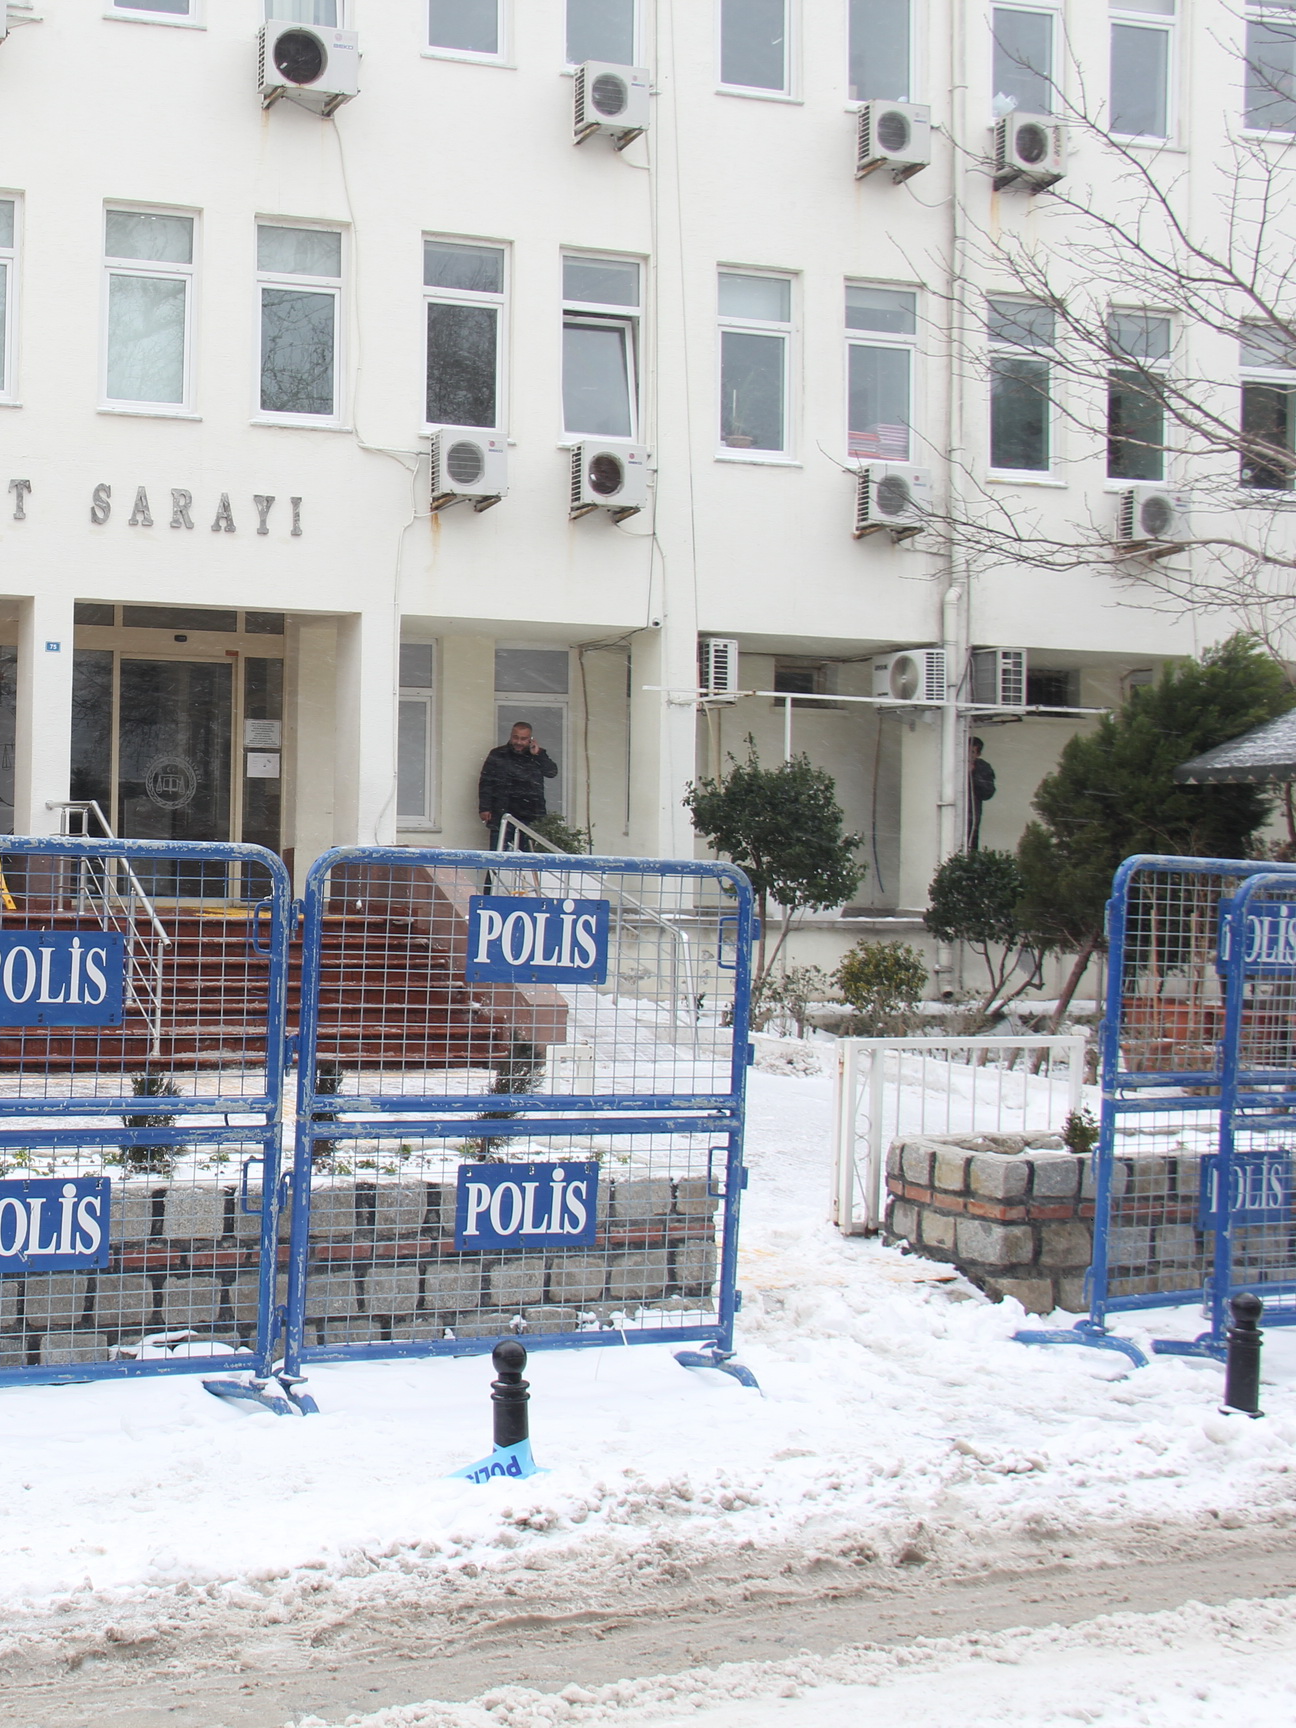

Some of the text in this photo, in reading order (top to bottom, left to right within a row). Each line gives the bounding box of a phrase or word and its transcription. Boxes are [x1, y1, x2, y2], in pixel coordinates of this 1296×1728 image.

[90, 482, 304, 537] SARAYI
[474, 897, 597, 969] POLİS
[463, 1168, 587, 1236] POLİS
